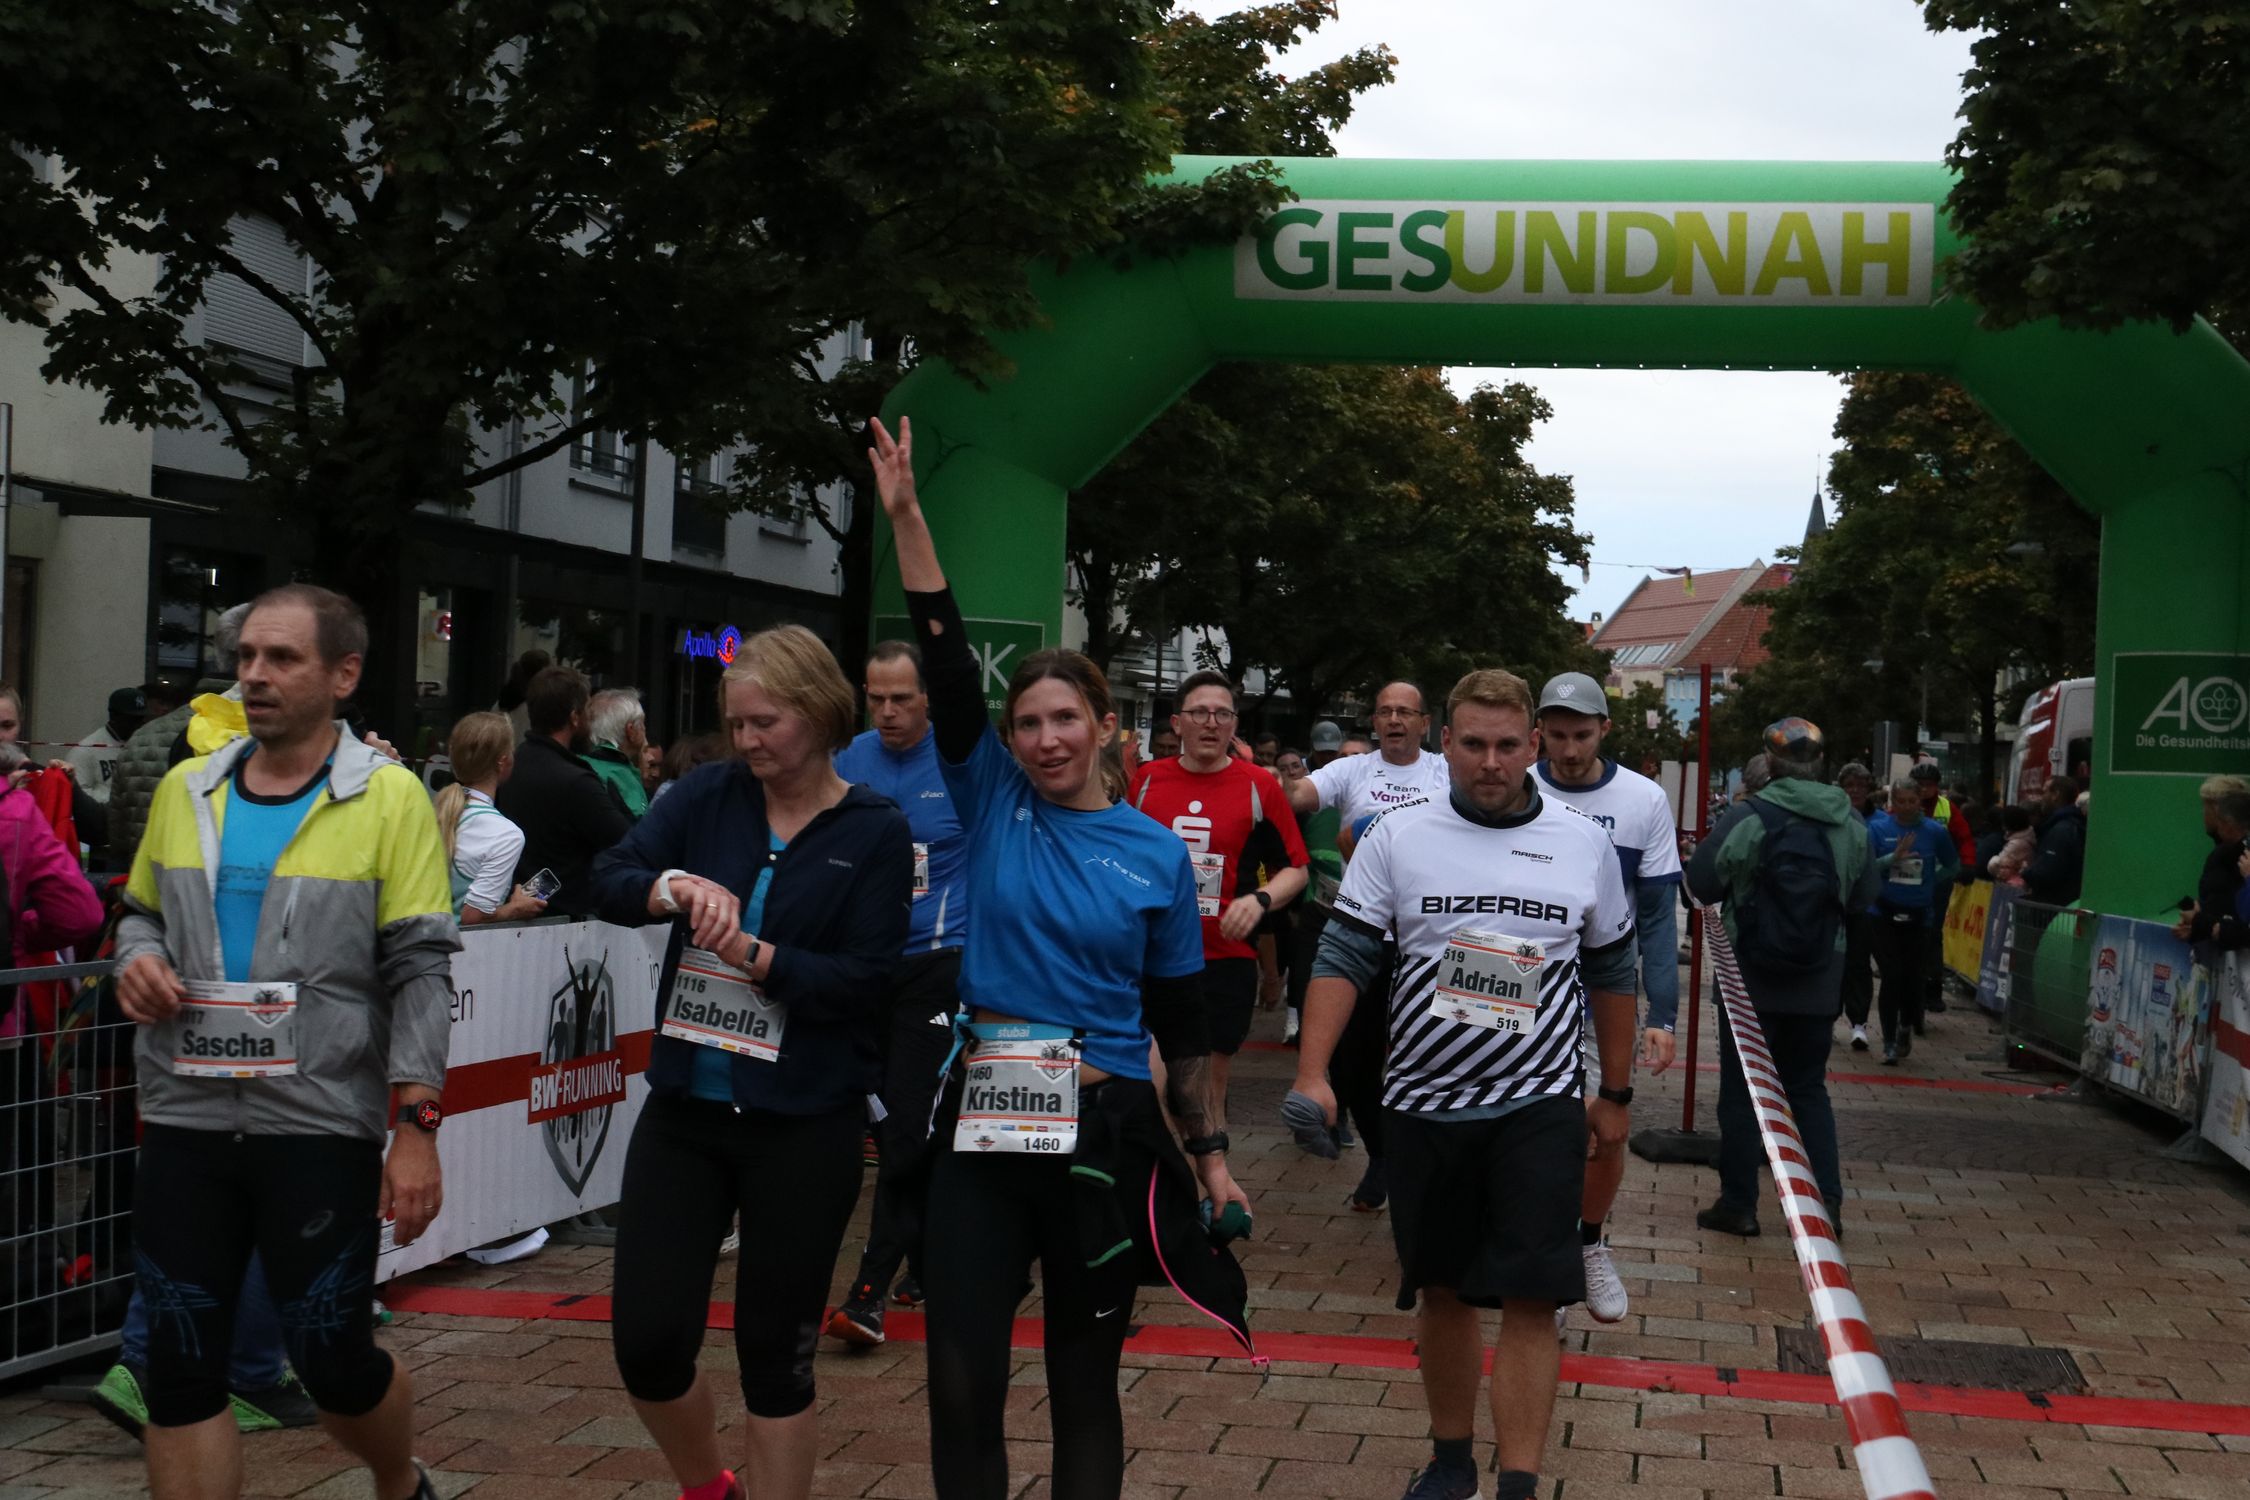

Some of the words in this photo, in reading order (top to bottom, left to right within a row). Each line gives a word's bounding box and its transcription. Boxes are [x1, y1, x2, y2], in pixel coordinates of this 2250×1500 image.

[1255, 206, 1911, 297] GESUNDNAH
[682, 628, 717, 662] Apollo
[2135, 734, 2156, 747] Die
[1385, 782, 1421, 793] Team
[1511, 849, 1553, 861] MAISCH
[1421, 895, 1568, 924] BIZERBA
[1443, 948, 1465, 963] 519
[676, 974, 707, 993] 1116
[1449, 966, 1523, 999] Adrian
[672, 994, 770, 1039] Isabella
[1496, 1017, 1519, 1031] 519
[997, 1025, 1031, 1038] stubai
[181, 1029, 275, 1057] Sascha
[968, 1066, 992, 1081] 1460
[530, 1058, 623, 1113] BW-RUNNING
[966, 1086, 1062, 1113] Kristina
[1023, 1136, 1060, 1151] 1460
